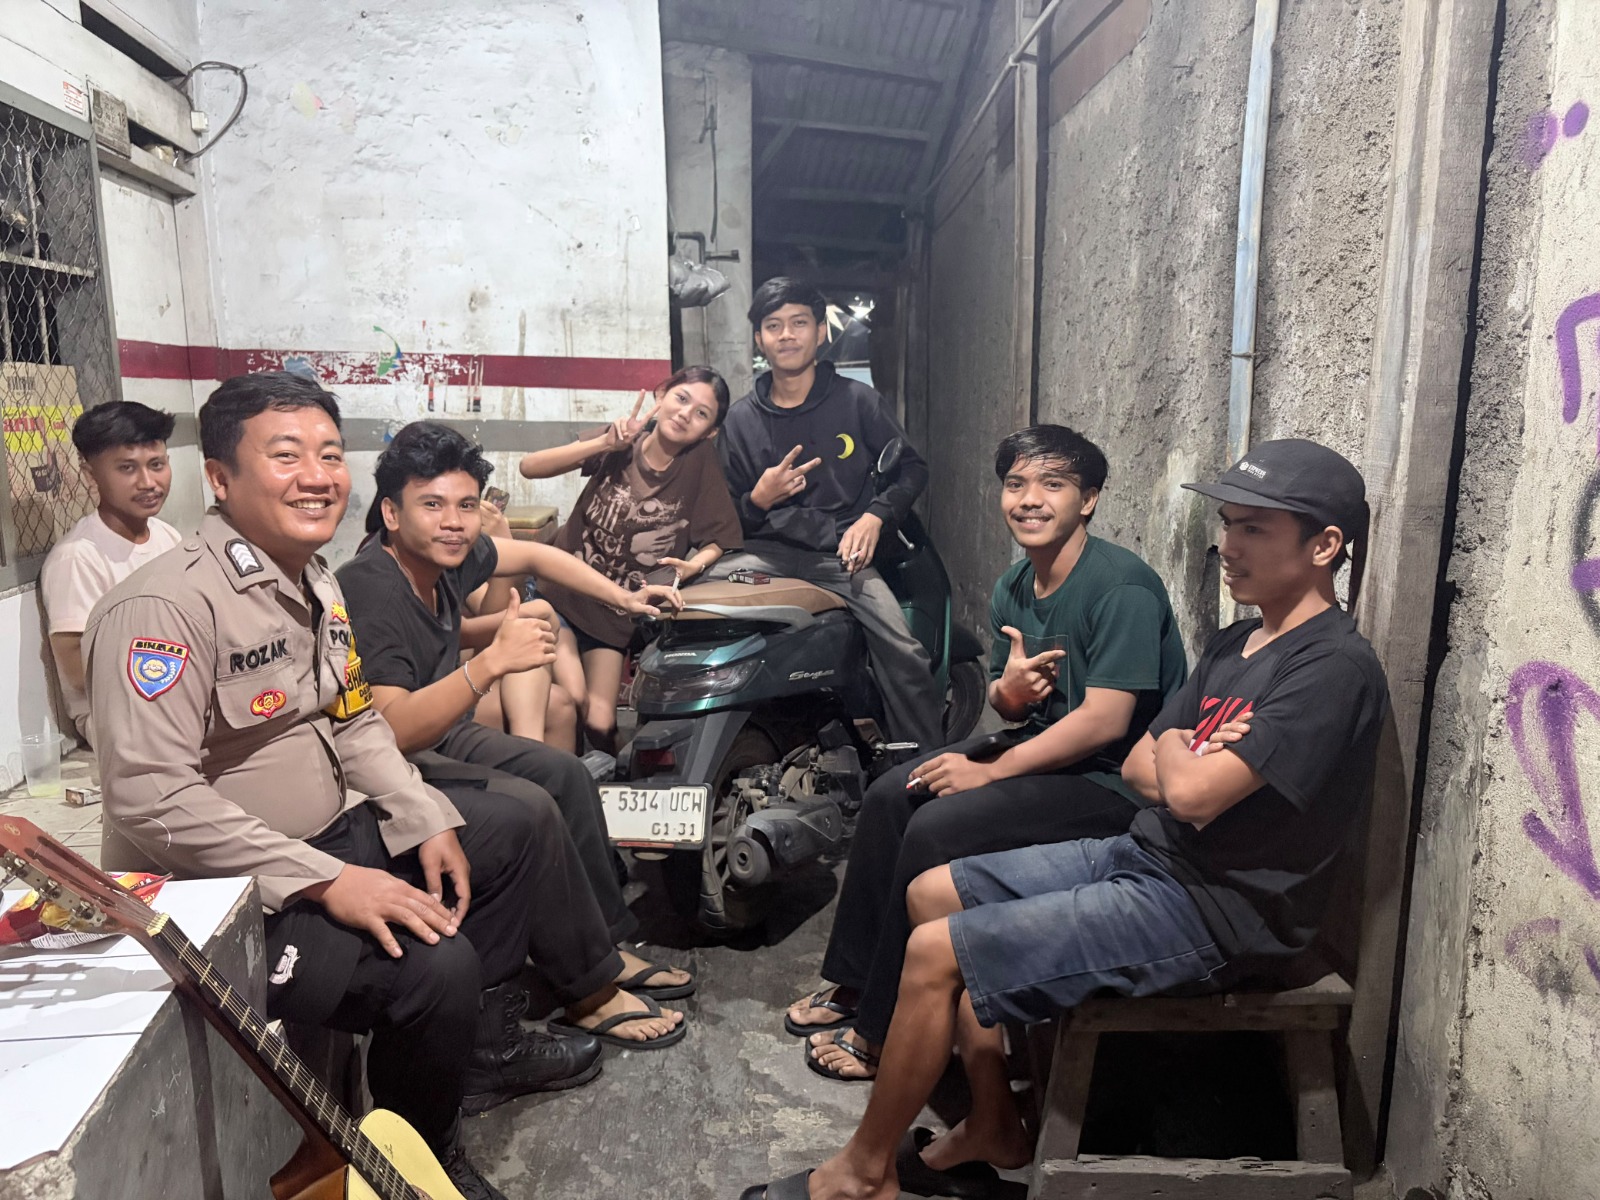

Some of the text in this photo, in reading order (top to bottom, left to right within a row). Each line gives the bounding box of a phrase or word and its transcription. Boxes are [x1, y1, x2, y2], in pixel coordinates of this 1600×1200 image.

[230, 638, 288, 674] ROZAK
[618, 791, 658, 812] 5314
[669, 791, 703, 812] UCW
